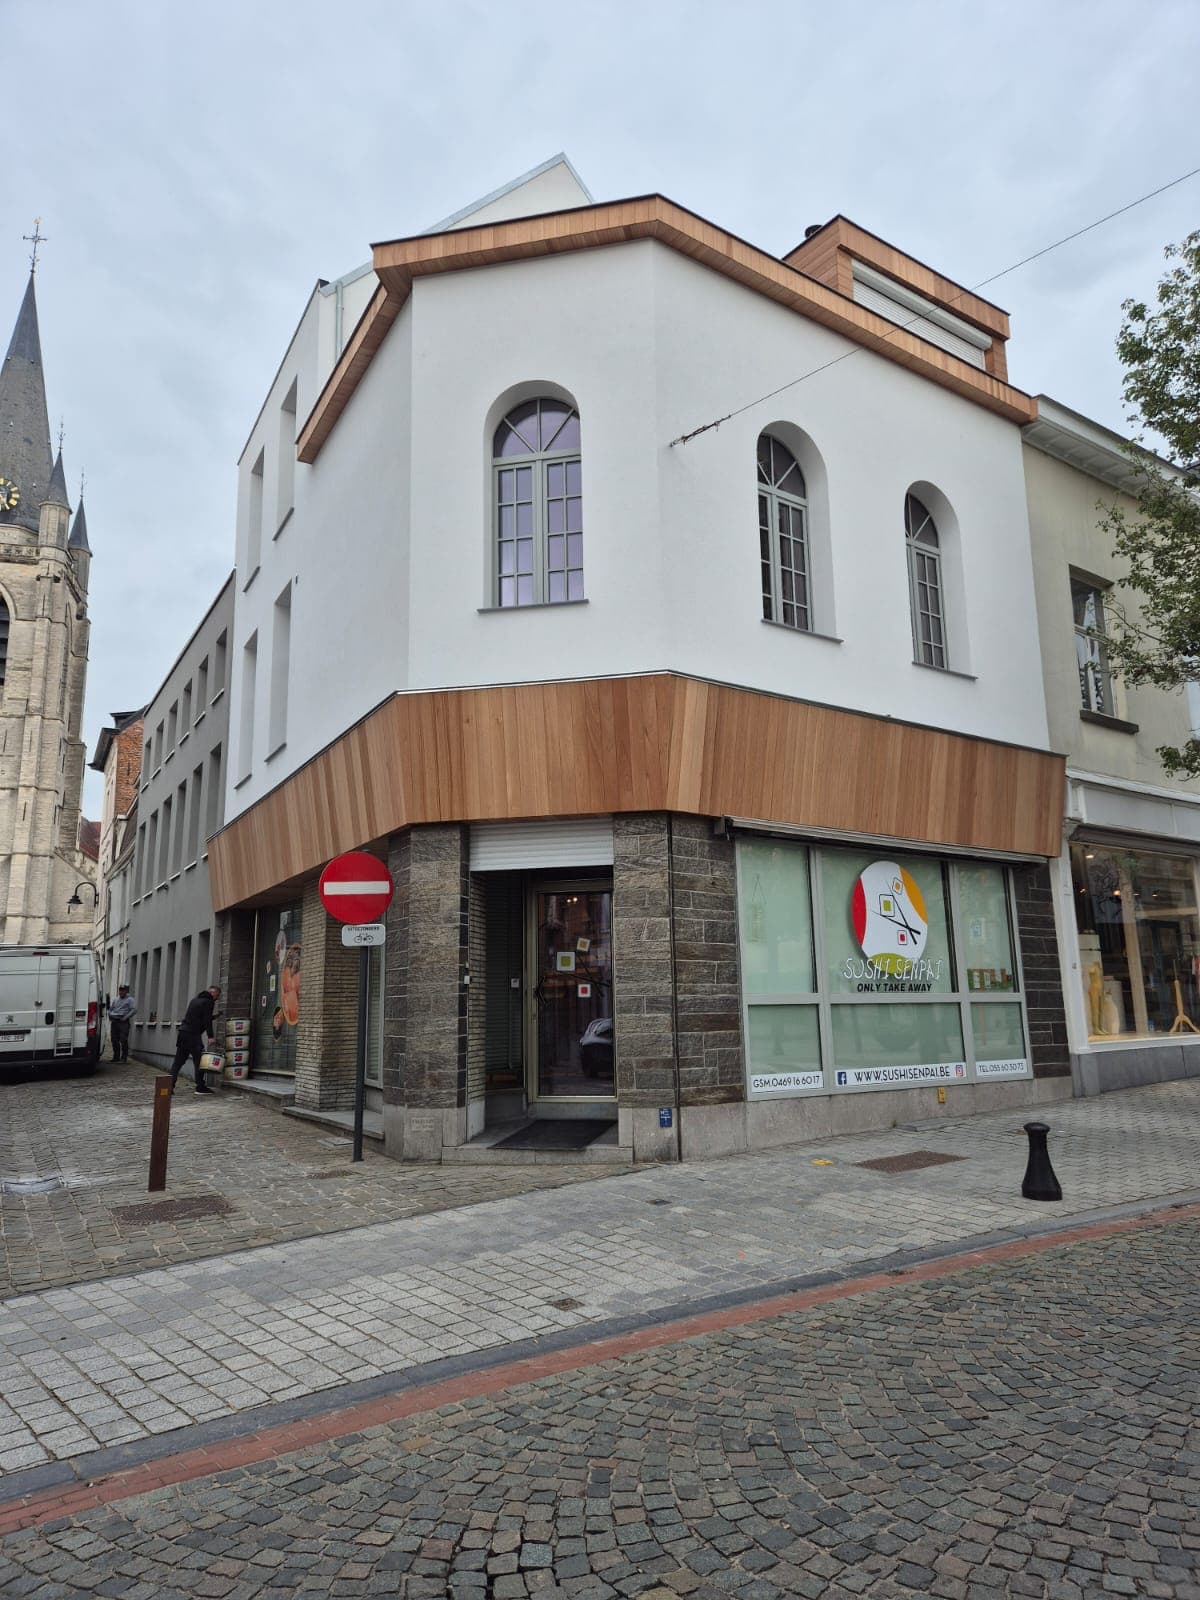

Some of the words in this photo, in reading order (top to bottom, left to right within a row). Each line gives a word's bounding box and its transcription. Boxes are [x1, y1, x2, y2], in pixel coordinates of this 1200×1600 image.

[843, 958, 890, 980] SUSHI
[893, 958, 943, 980] SENPAI
[857, 983, 881, 992] ONLY
[883, 983, 905, 992] TAKE
[908, 983, 933, 992] AWAY
[854, 1066, 951, 1082] WWW.SUSHISENPAI.BE
